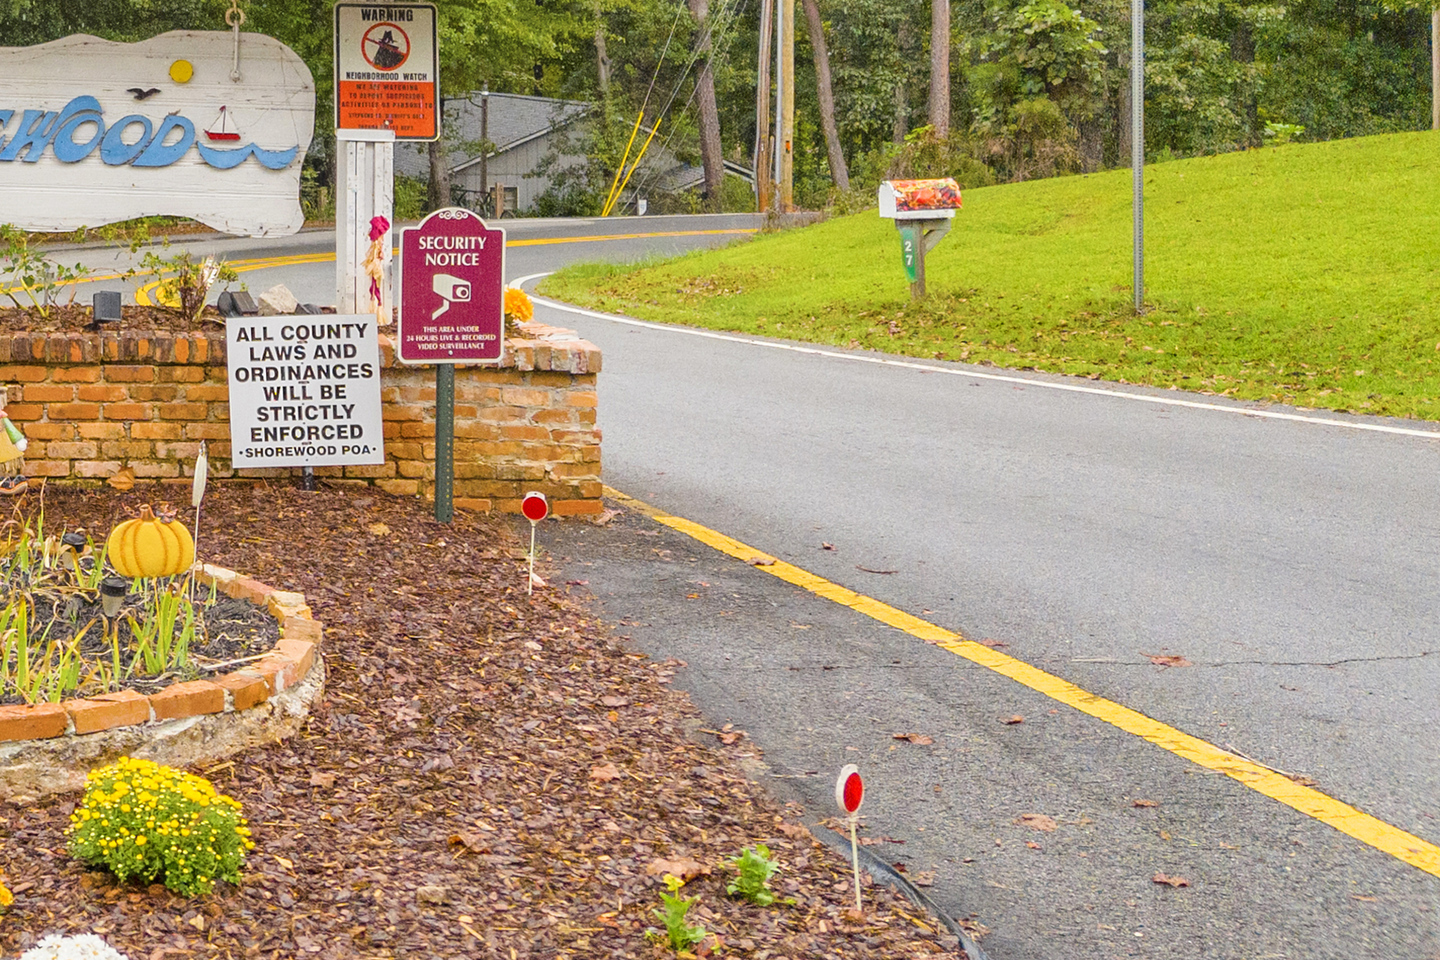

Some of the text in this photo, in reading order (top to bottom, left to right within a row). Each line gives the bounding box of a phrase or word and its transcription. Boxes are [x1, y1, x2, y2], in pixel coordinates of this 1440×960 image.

[361, 8, 413, 21] WARNING
[346, 71, 427, 81] NEIGHBORHOOD WATCH
[418, 236, 486, 250] SECURITY
[425, 253, 480, 266] NOTICE
[904, 240, 913, 266] 27
[236, 323, 368, 342] ALL COUNTY
[249, 343, 357, 362] LAWS AND
[235, 363, 373, 383] ORDINANCES
[263, 384, 346, 402] WILL BE
[257, 404, 355, 422] STRICTLY
[250, 424, 363, 442] ENFORCED
